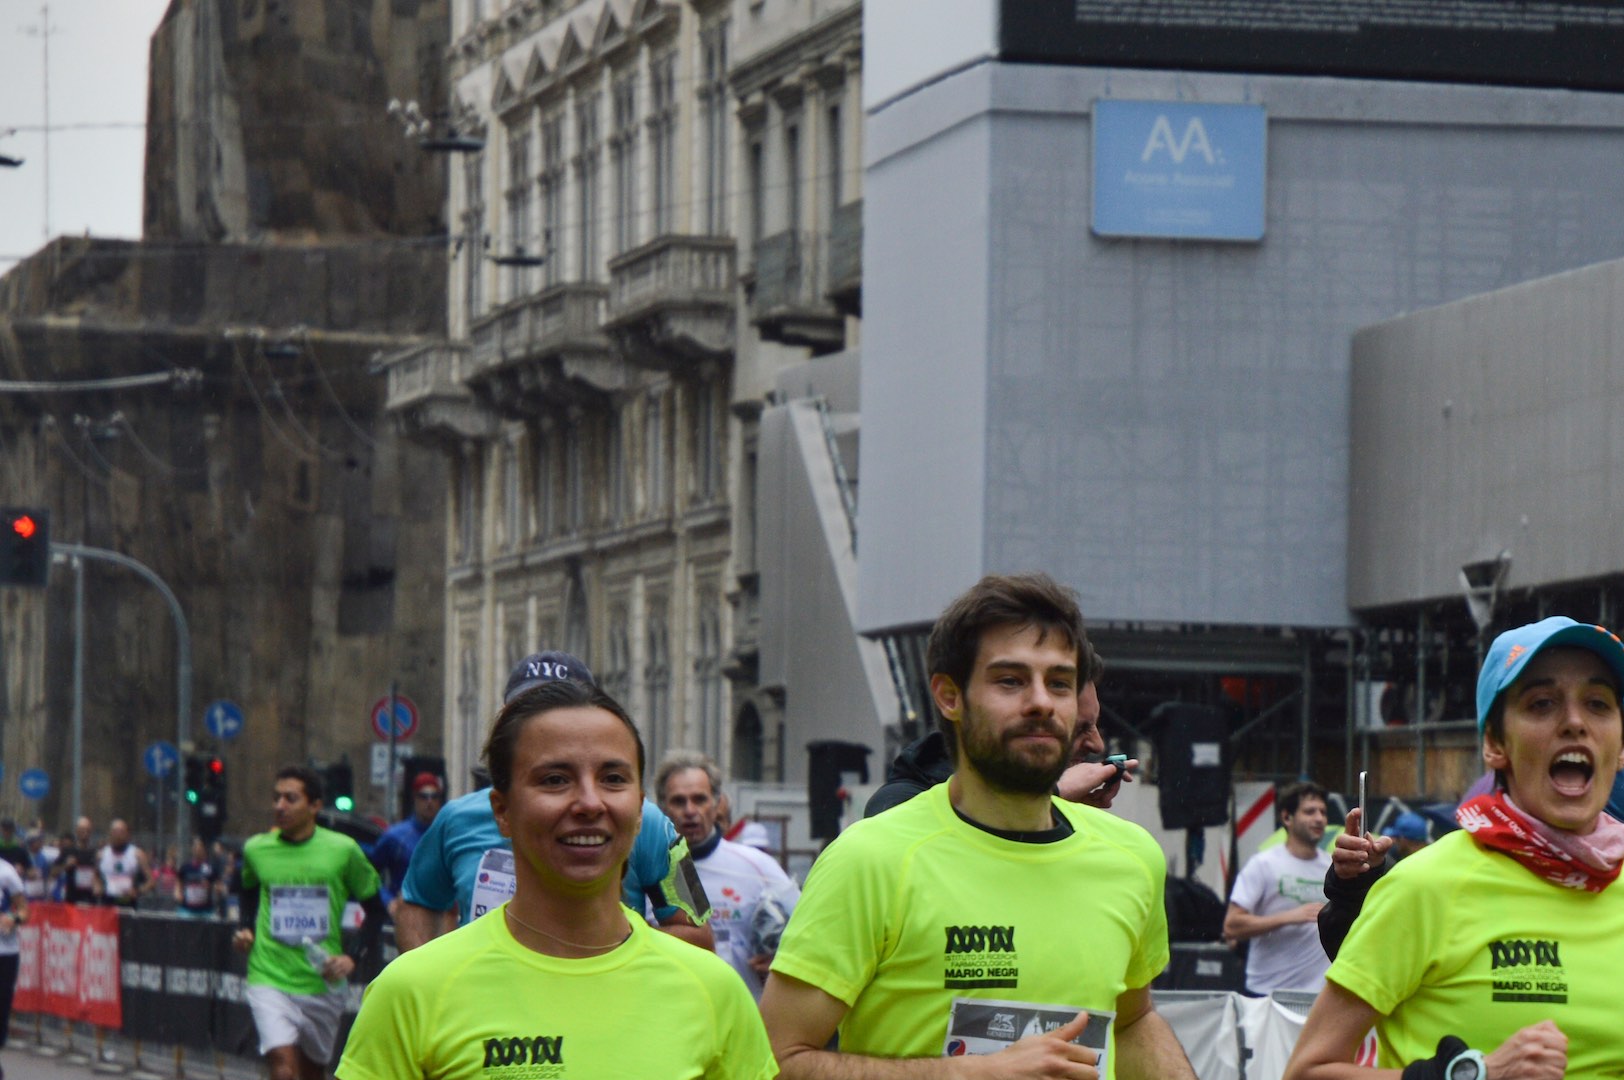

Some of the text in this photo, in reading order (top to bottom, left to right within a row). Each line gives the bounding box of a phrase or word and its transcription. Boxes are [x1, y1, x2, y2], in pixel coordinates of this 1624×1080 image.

[525, 662, 569, 680] NYC
[945, 967, 1019, 978] MARIO NEGRI
[1493, 981, 1568, 992] MARIO NEGRI
